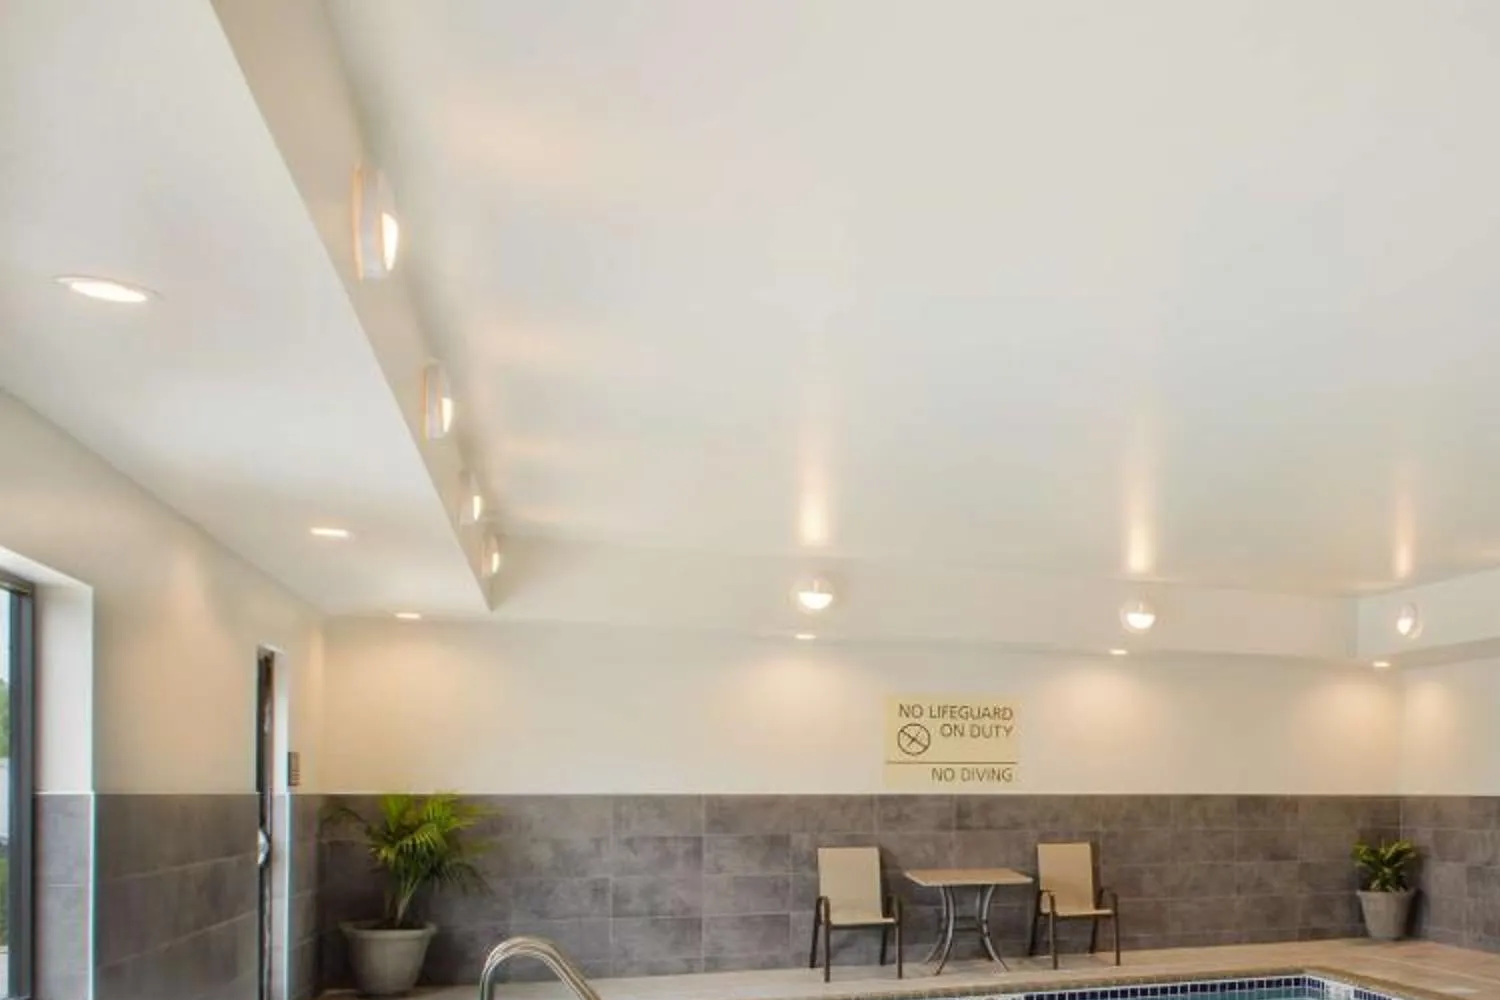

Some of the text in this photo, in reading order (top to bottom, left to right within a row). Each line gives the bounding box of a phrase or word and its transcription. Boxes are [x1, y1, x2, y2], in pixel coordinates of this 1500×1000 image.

[899, 703, 1014, 721] NO LIFEGUARD
[940, 723, 1014, 739] ON DUTY
[931, 767, 1014, 782] NO DIVING
